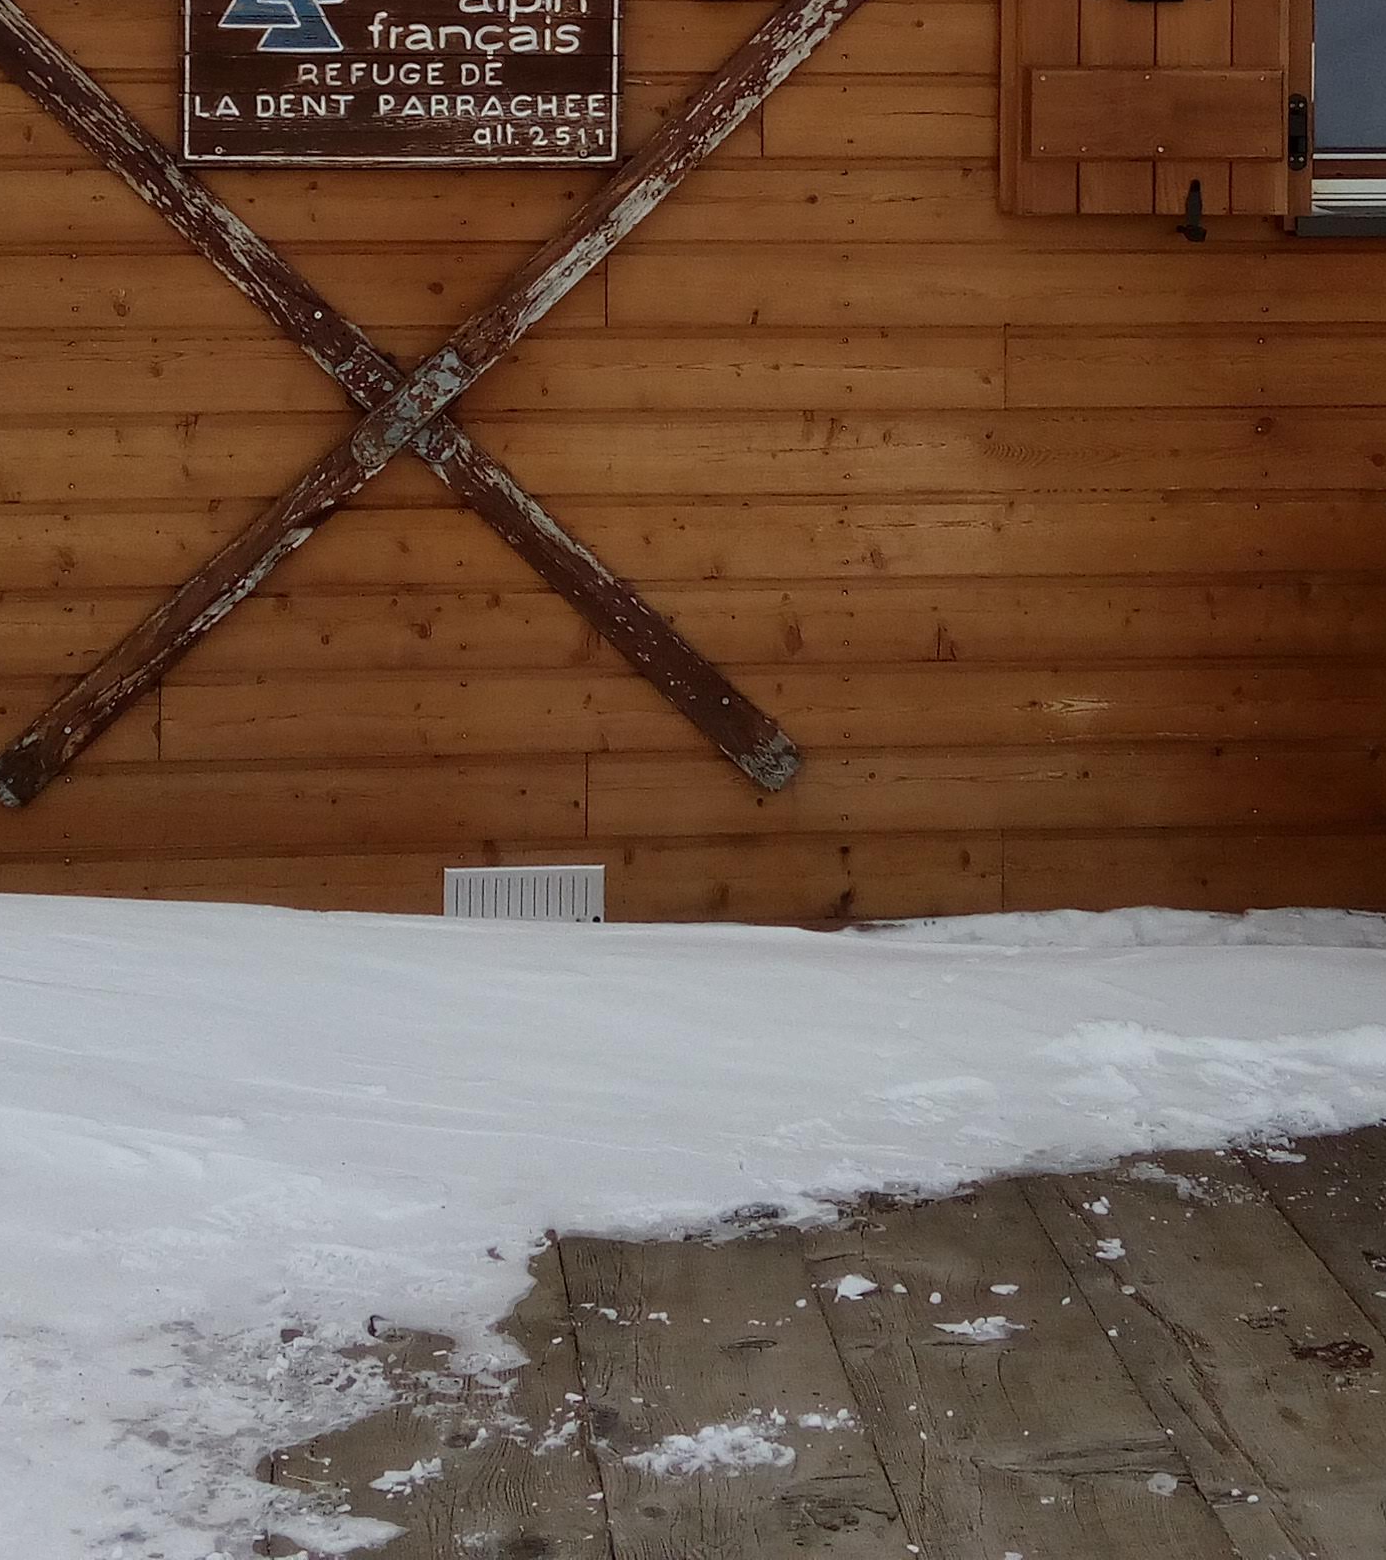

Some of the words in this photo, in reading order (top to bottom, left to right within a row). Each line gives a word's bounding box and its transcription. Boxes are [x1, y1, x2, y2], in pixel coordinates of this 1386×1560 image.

[367, 11, 582, 60] français
[297, 62, 446, 87] REFUGE
[460, 62, 504, 87] DE
[193, 94, 241, 118] LA
[256, 94, 355, 118] DENT
[377, 93, 607, 119] PARRACHEE
